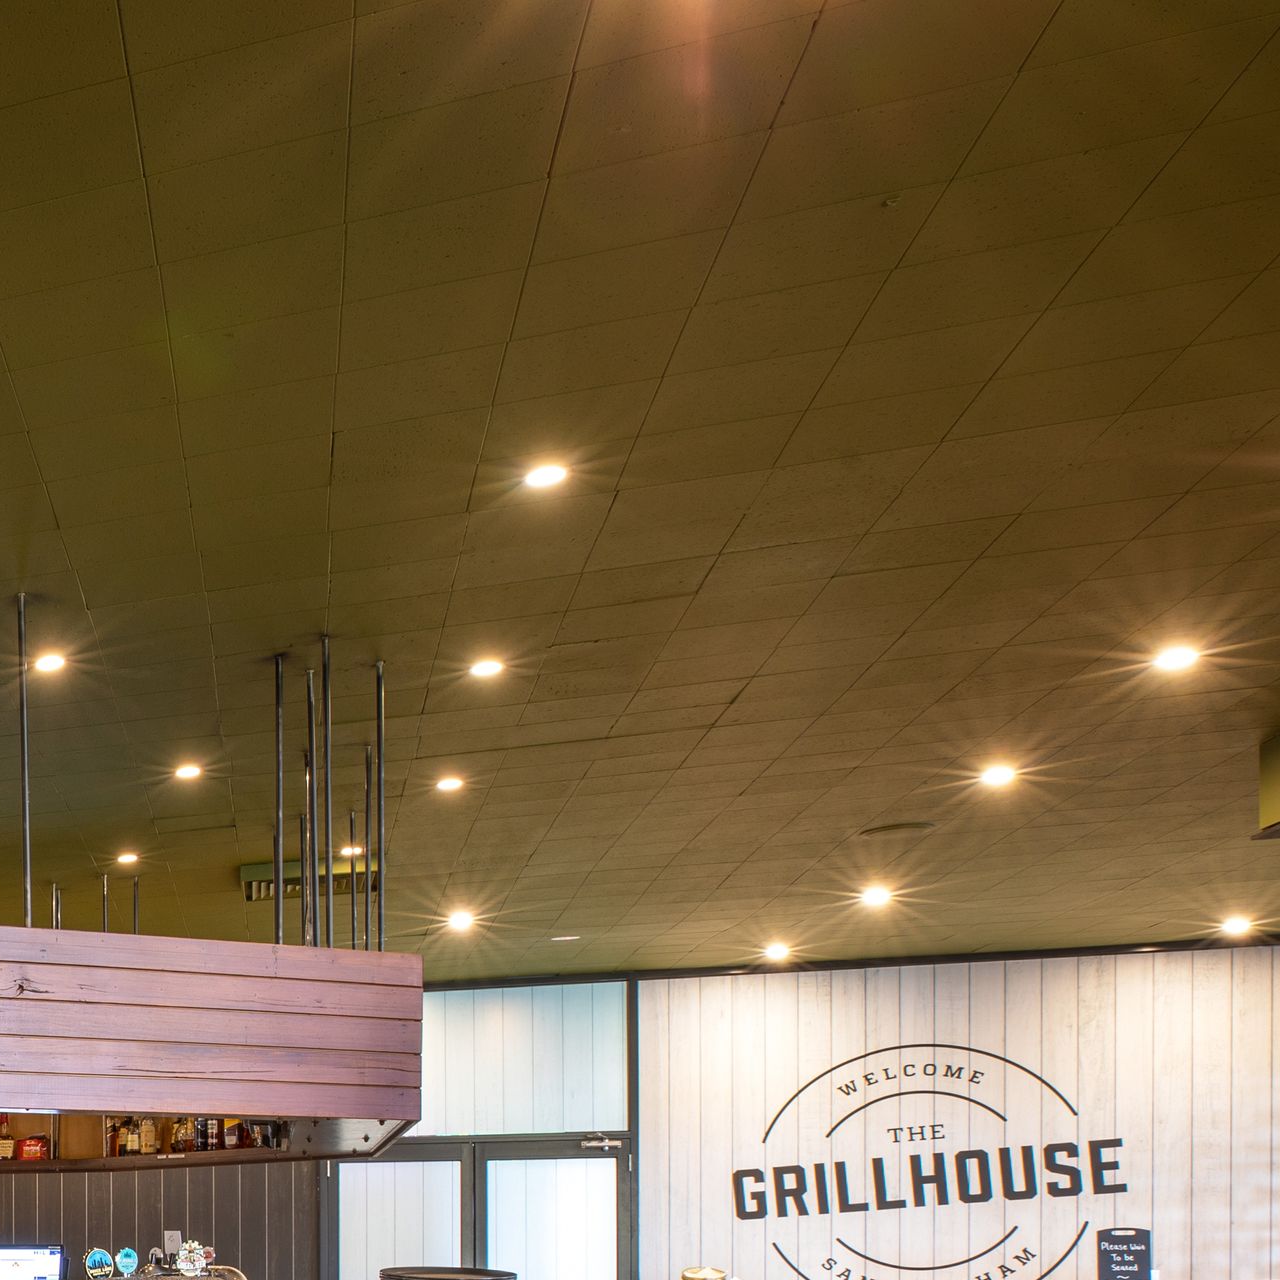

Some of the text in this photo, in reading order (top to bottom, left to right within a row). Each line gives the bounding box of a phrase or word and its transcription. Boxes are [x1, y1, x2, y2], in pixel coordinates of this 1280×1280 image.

[836, 1062, 986, 1097] WELCOME
[886, 1123, 946, 1144] THE
[732, 1138, 1128, 1221] GRILLHOUSE
[1100, 1241, 1128, 1251] Please
[1110, 1253, 1135, 1262] To be
[1110, 1263, 1139, 1271] Seated
